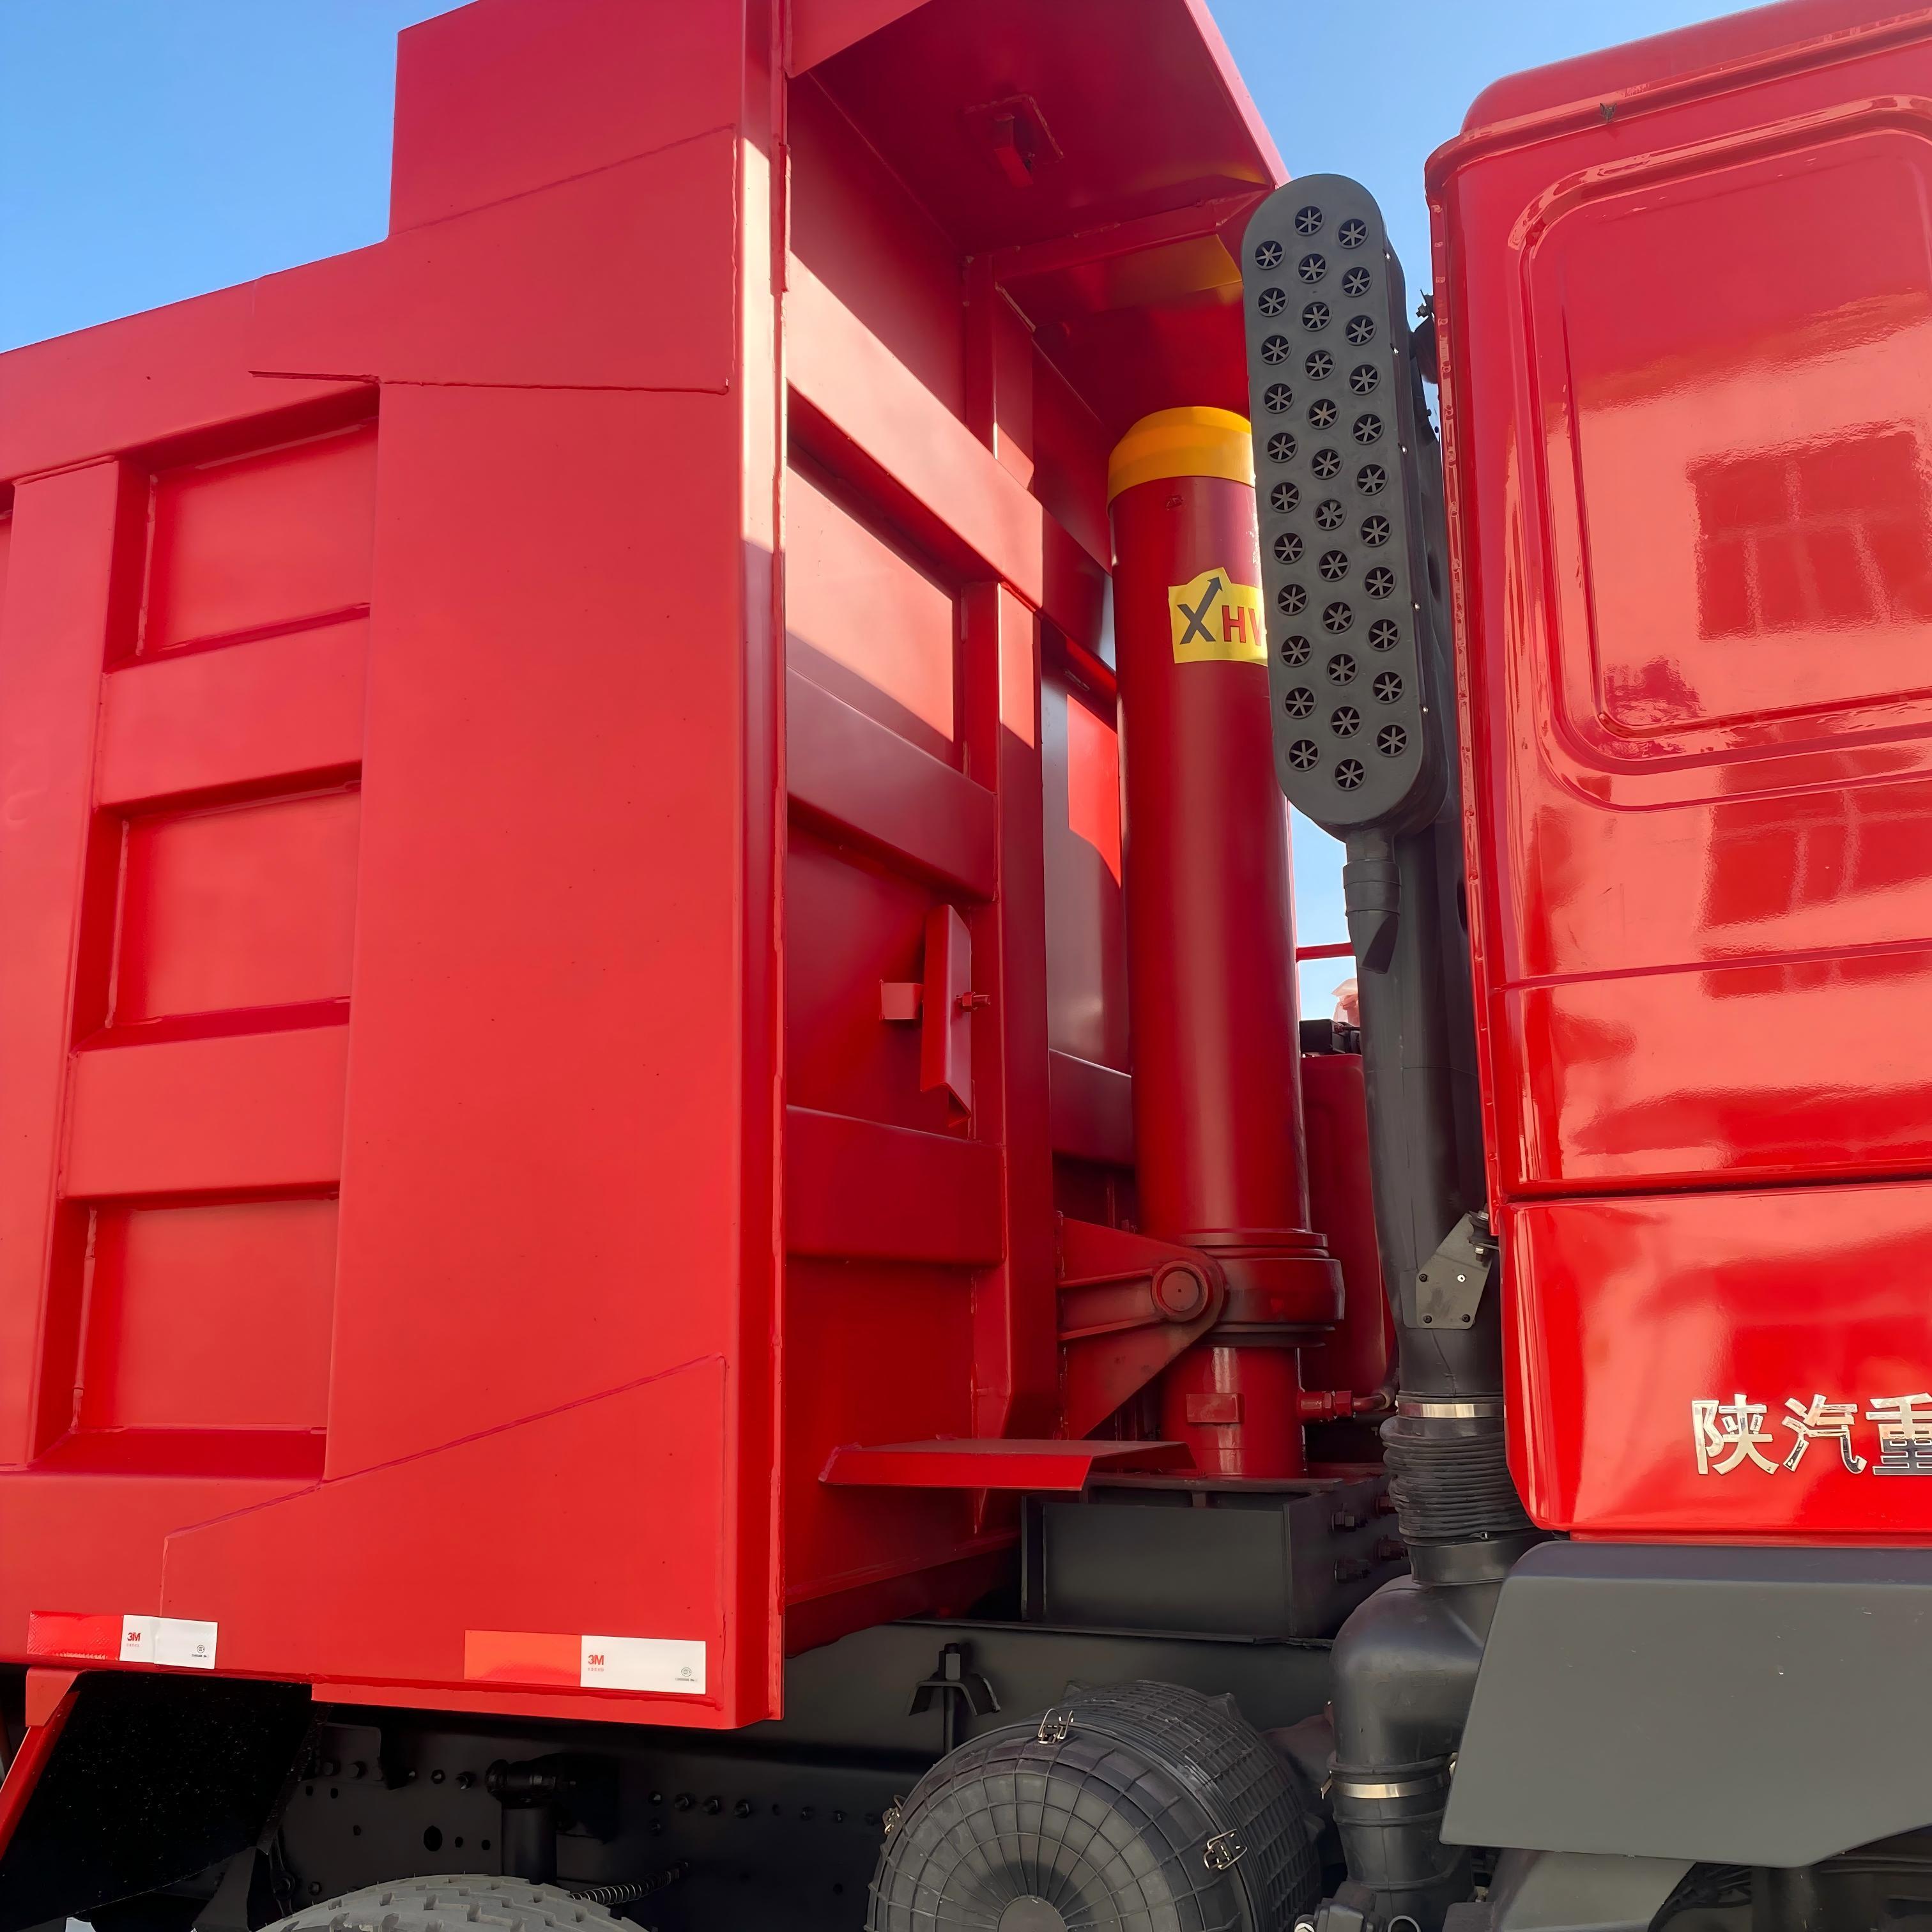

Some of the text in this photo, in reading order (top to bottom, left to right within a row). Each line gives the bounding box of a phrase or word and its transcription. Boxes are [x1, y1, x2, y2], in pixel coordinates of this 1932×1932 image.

[1690, 1392, 1932, 1476] 陕汽重
[126, 1632, 141, 1643] 3M
[587, 1654, 604, 1666] 3M
